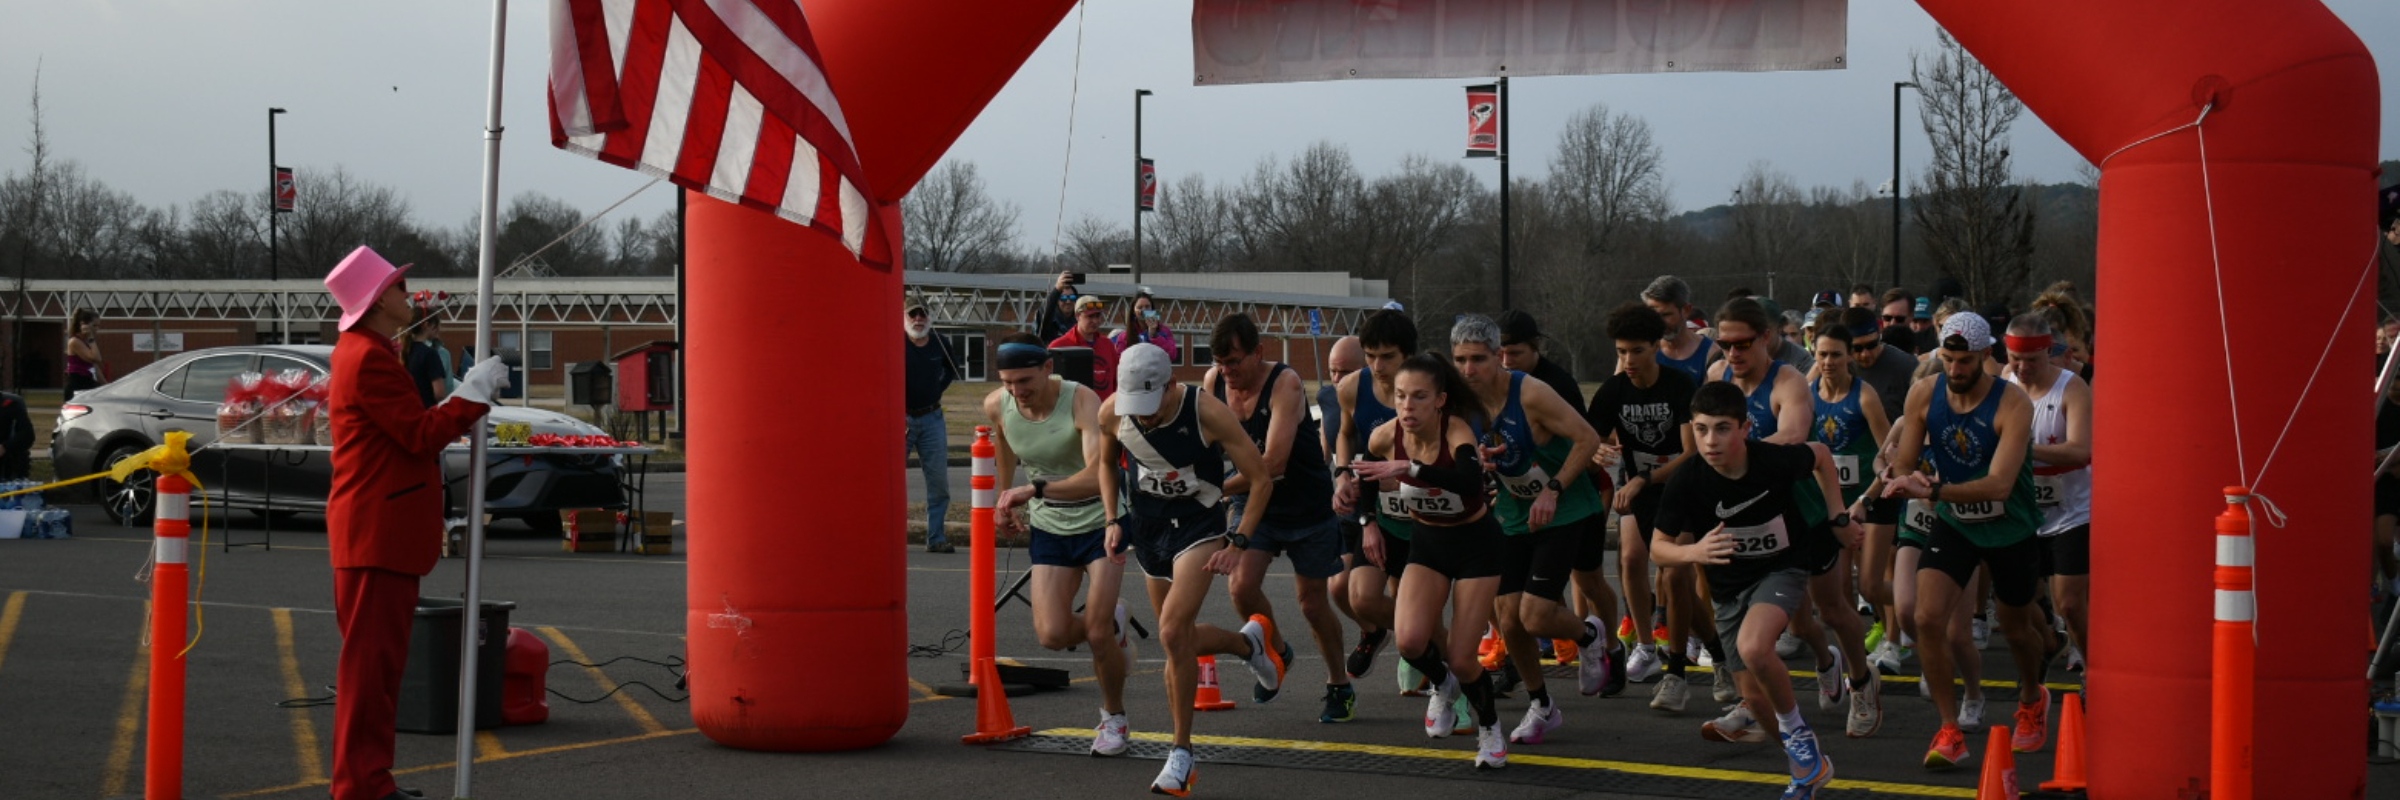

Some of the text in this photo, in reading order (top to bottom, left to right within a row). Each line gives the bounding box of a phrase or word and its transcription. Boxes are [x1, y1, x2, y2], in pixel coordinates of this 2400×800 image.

[1622, 402, 1671, 418] PIRATES
[1147, 476, 1188, 495] 763
[1511, 479, 1543, 496] 499
[1411, 497, 1453, 511] 752
[1732, 534, 1778, 553] 526
